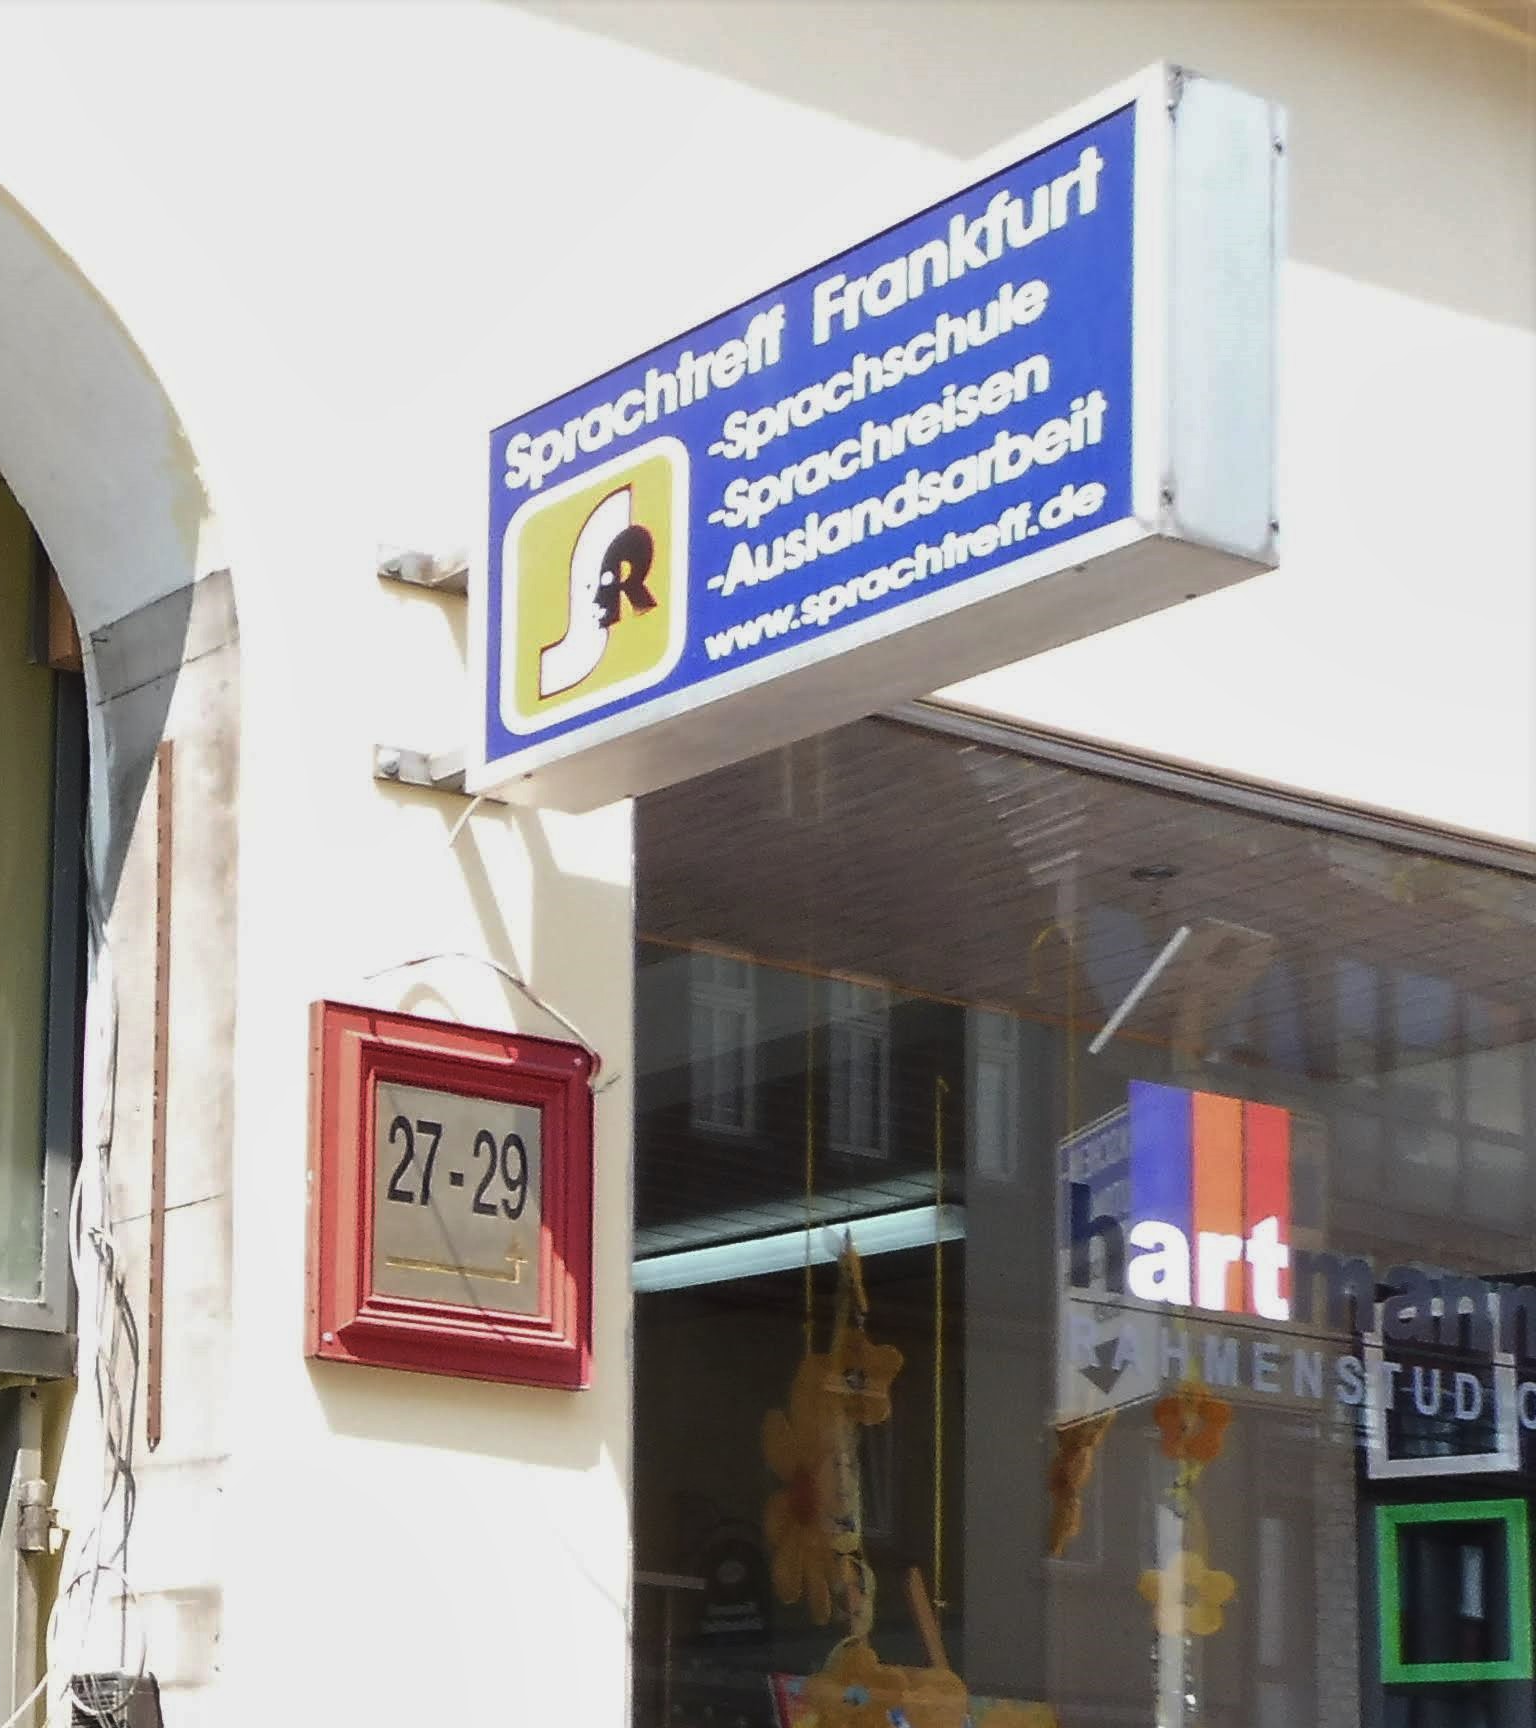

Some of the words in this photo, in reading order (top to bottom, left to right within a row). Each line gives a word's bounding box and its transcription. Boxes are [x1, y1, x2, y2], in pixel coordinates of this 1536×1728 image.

[504, 303, 786, 490] Sprachtreff
[812, 146, 1104, 346] Frankfurt
[704, 481, 1107, 660] www.sprachtreff.de
